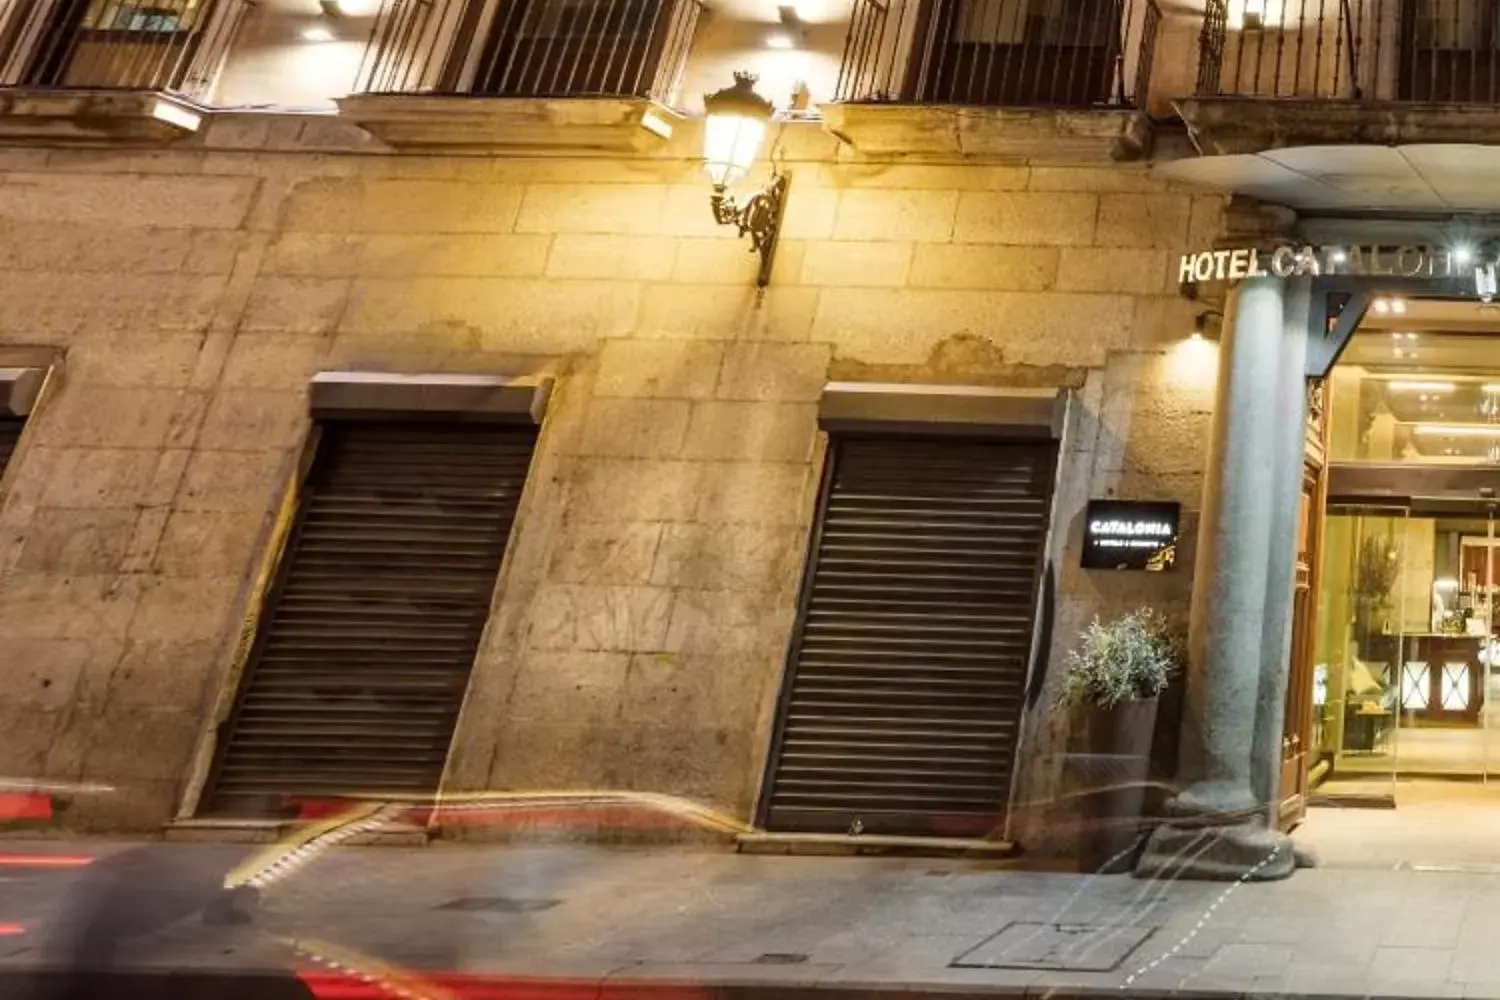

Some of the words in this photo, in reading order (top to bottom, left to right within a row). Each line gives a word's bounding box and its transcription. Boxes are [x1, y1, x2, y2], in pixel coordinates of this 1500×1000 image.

[1178, 248, 1268, 283] HOTEL
[1271, 246, 1492, 277] CATALON
[1090, 521, 1171, 535] CATALONIA
